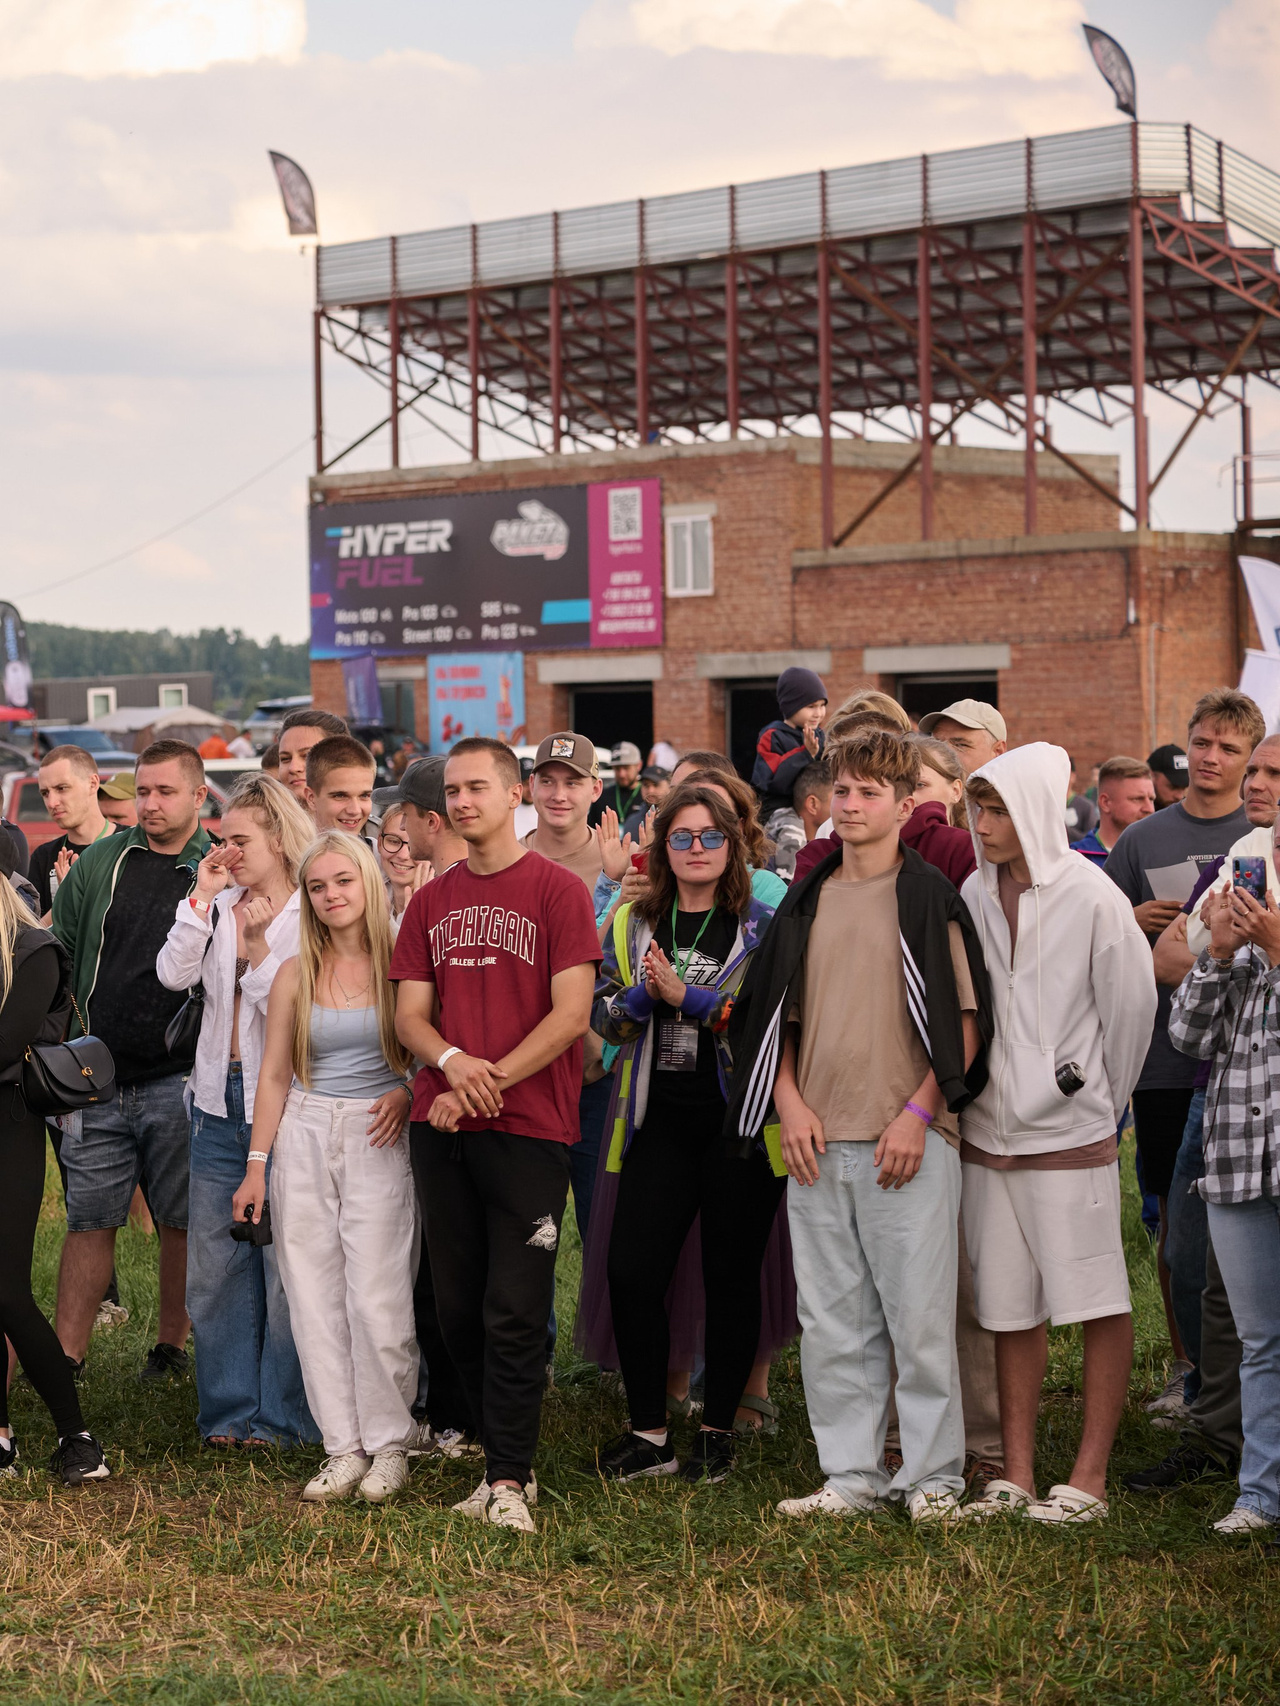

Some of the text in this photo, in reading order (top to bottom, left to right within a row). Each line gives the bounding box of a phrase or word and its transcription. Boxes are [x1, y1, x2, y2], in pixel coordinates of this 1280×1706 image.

[338, 519, 453, 558] HYPER
[335, 556, 424, 590] FUEL
[402, 605, 419, 621] Pro
[335, 630, 353, 647] Pro
[481, 624, 500, 640] Pro
[428, 905, 537, 967] MICHIGAN
[449, 957, 476, 966] COLLEGE
